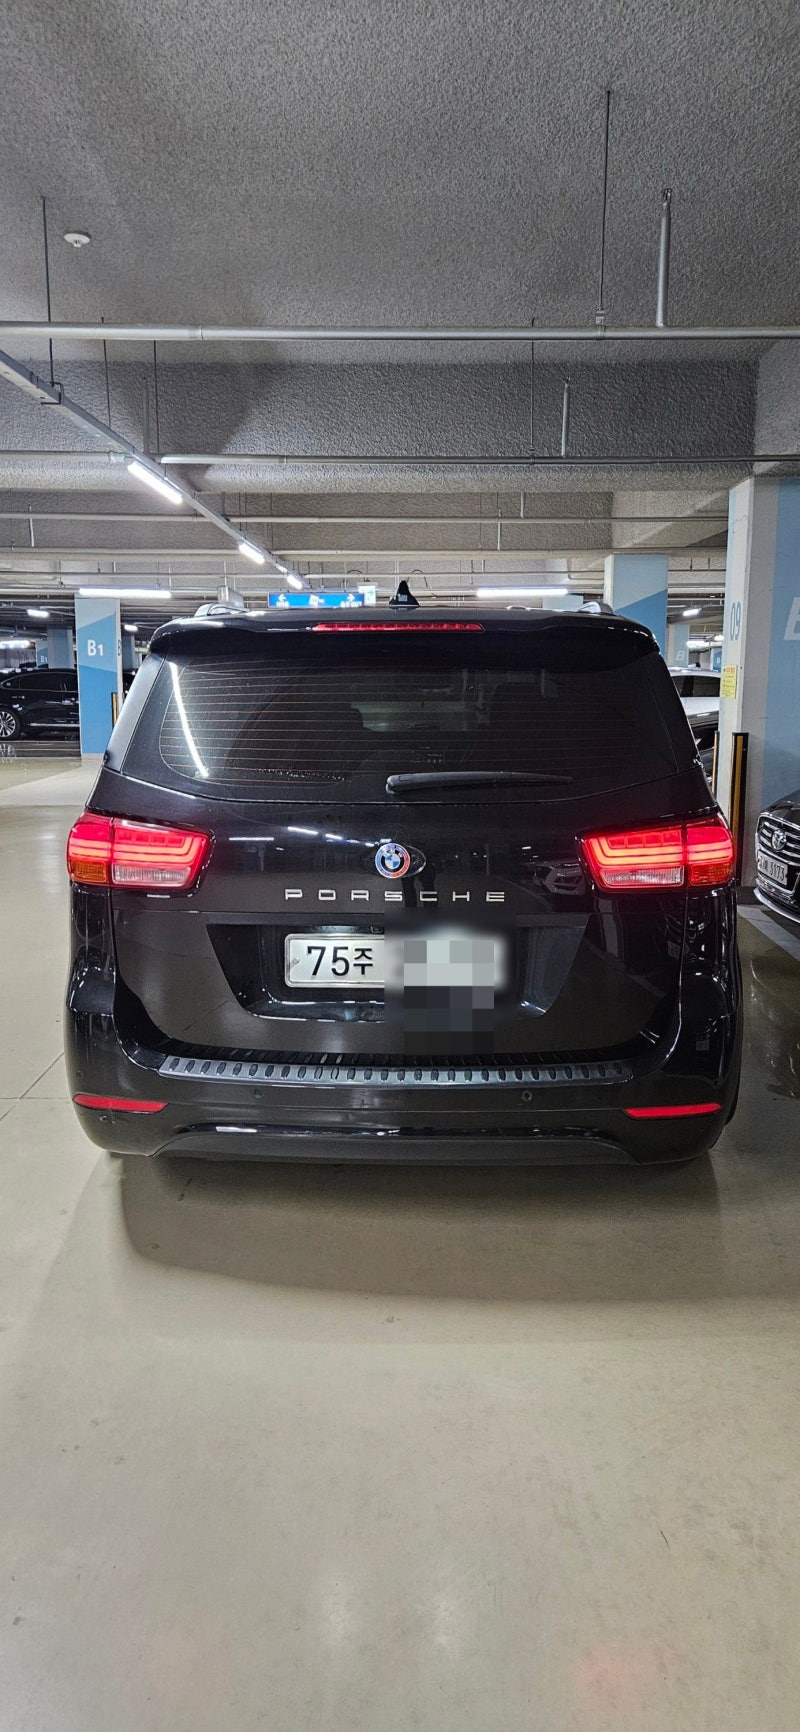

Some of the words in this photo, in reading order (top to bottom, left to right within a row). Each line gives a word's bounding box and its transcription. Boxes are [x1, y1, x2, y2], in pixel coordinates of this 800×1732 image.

[730, 601, 741, 641] 09
[87, 640, 104, 656] B1
[284, 888, 505, 902] PORSCHE
[307, 945, 374, 977] 75주
